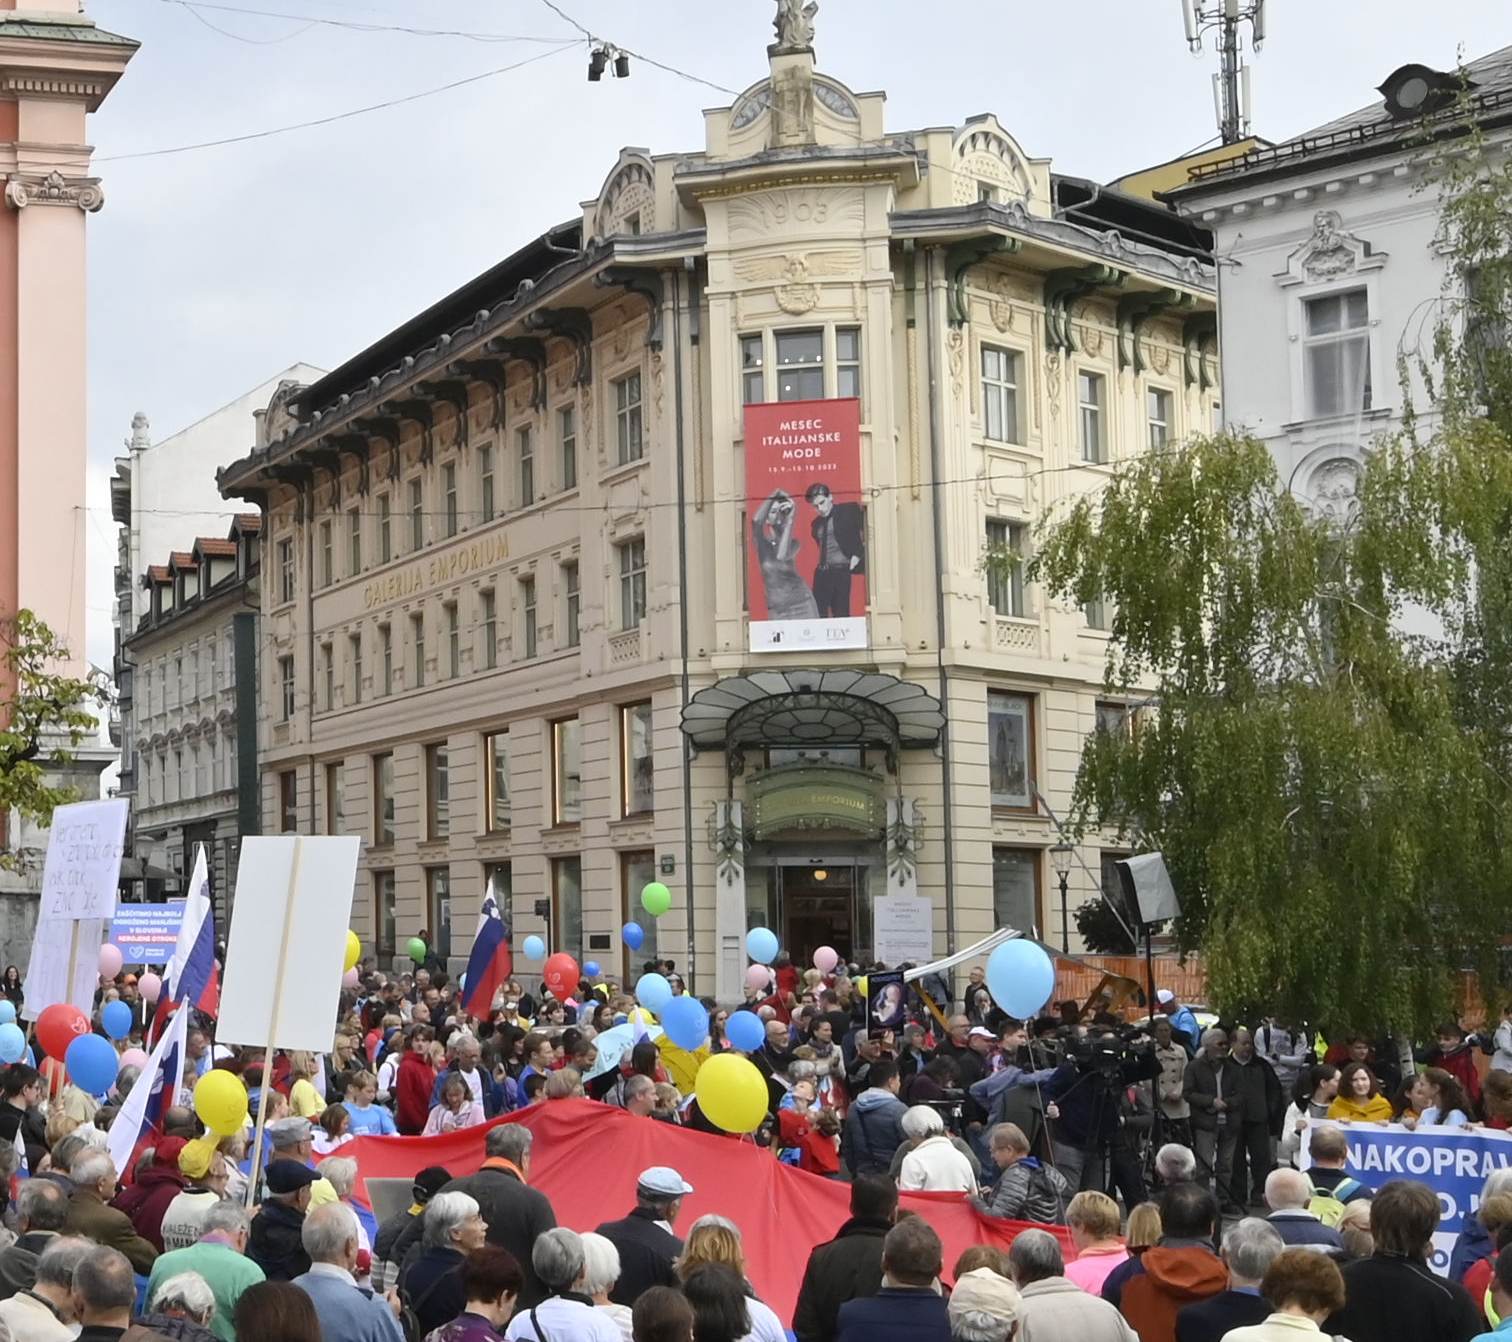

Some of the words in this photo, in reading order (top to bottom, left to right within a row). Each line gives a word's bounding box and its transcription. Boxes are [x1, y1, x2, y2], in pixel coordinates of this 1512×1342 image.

[780, 419, 822, 431] MESEC
[762, 432, 841, 446] ITALIJANSKE
[782, 448, 821, 459] MODE
